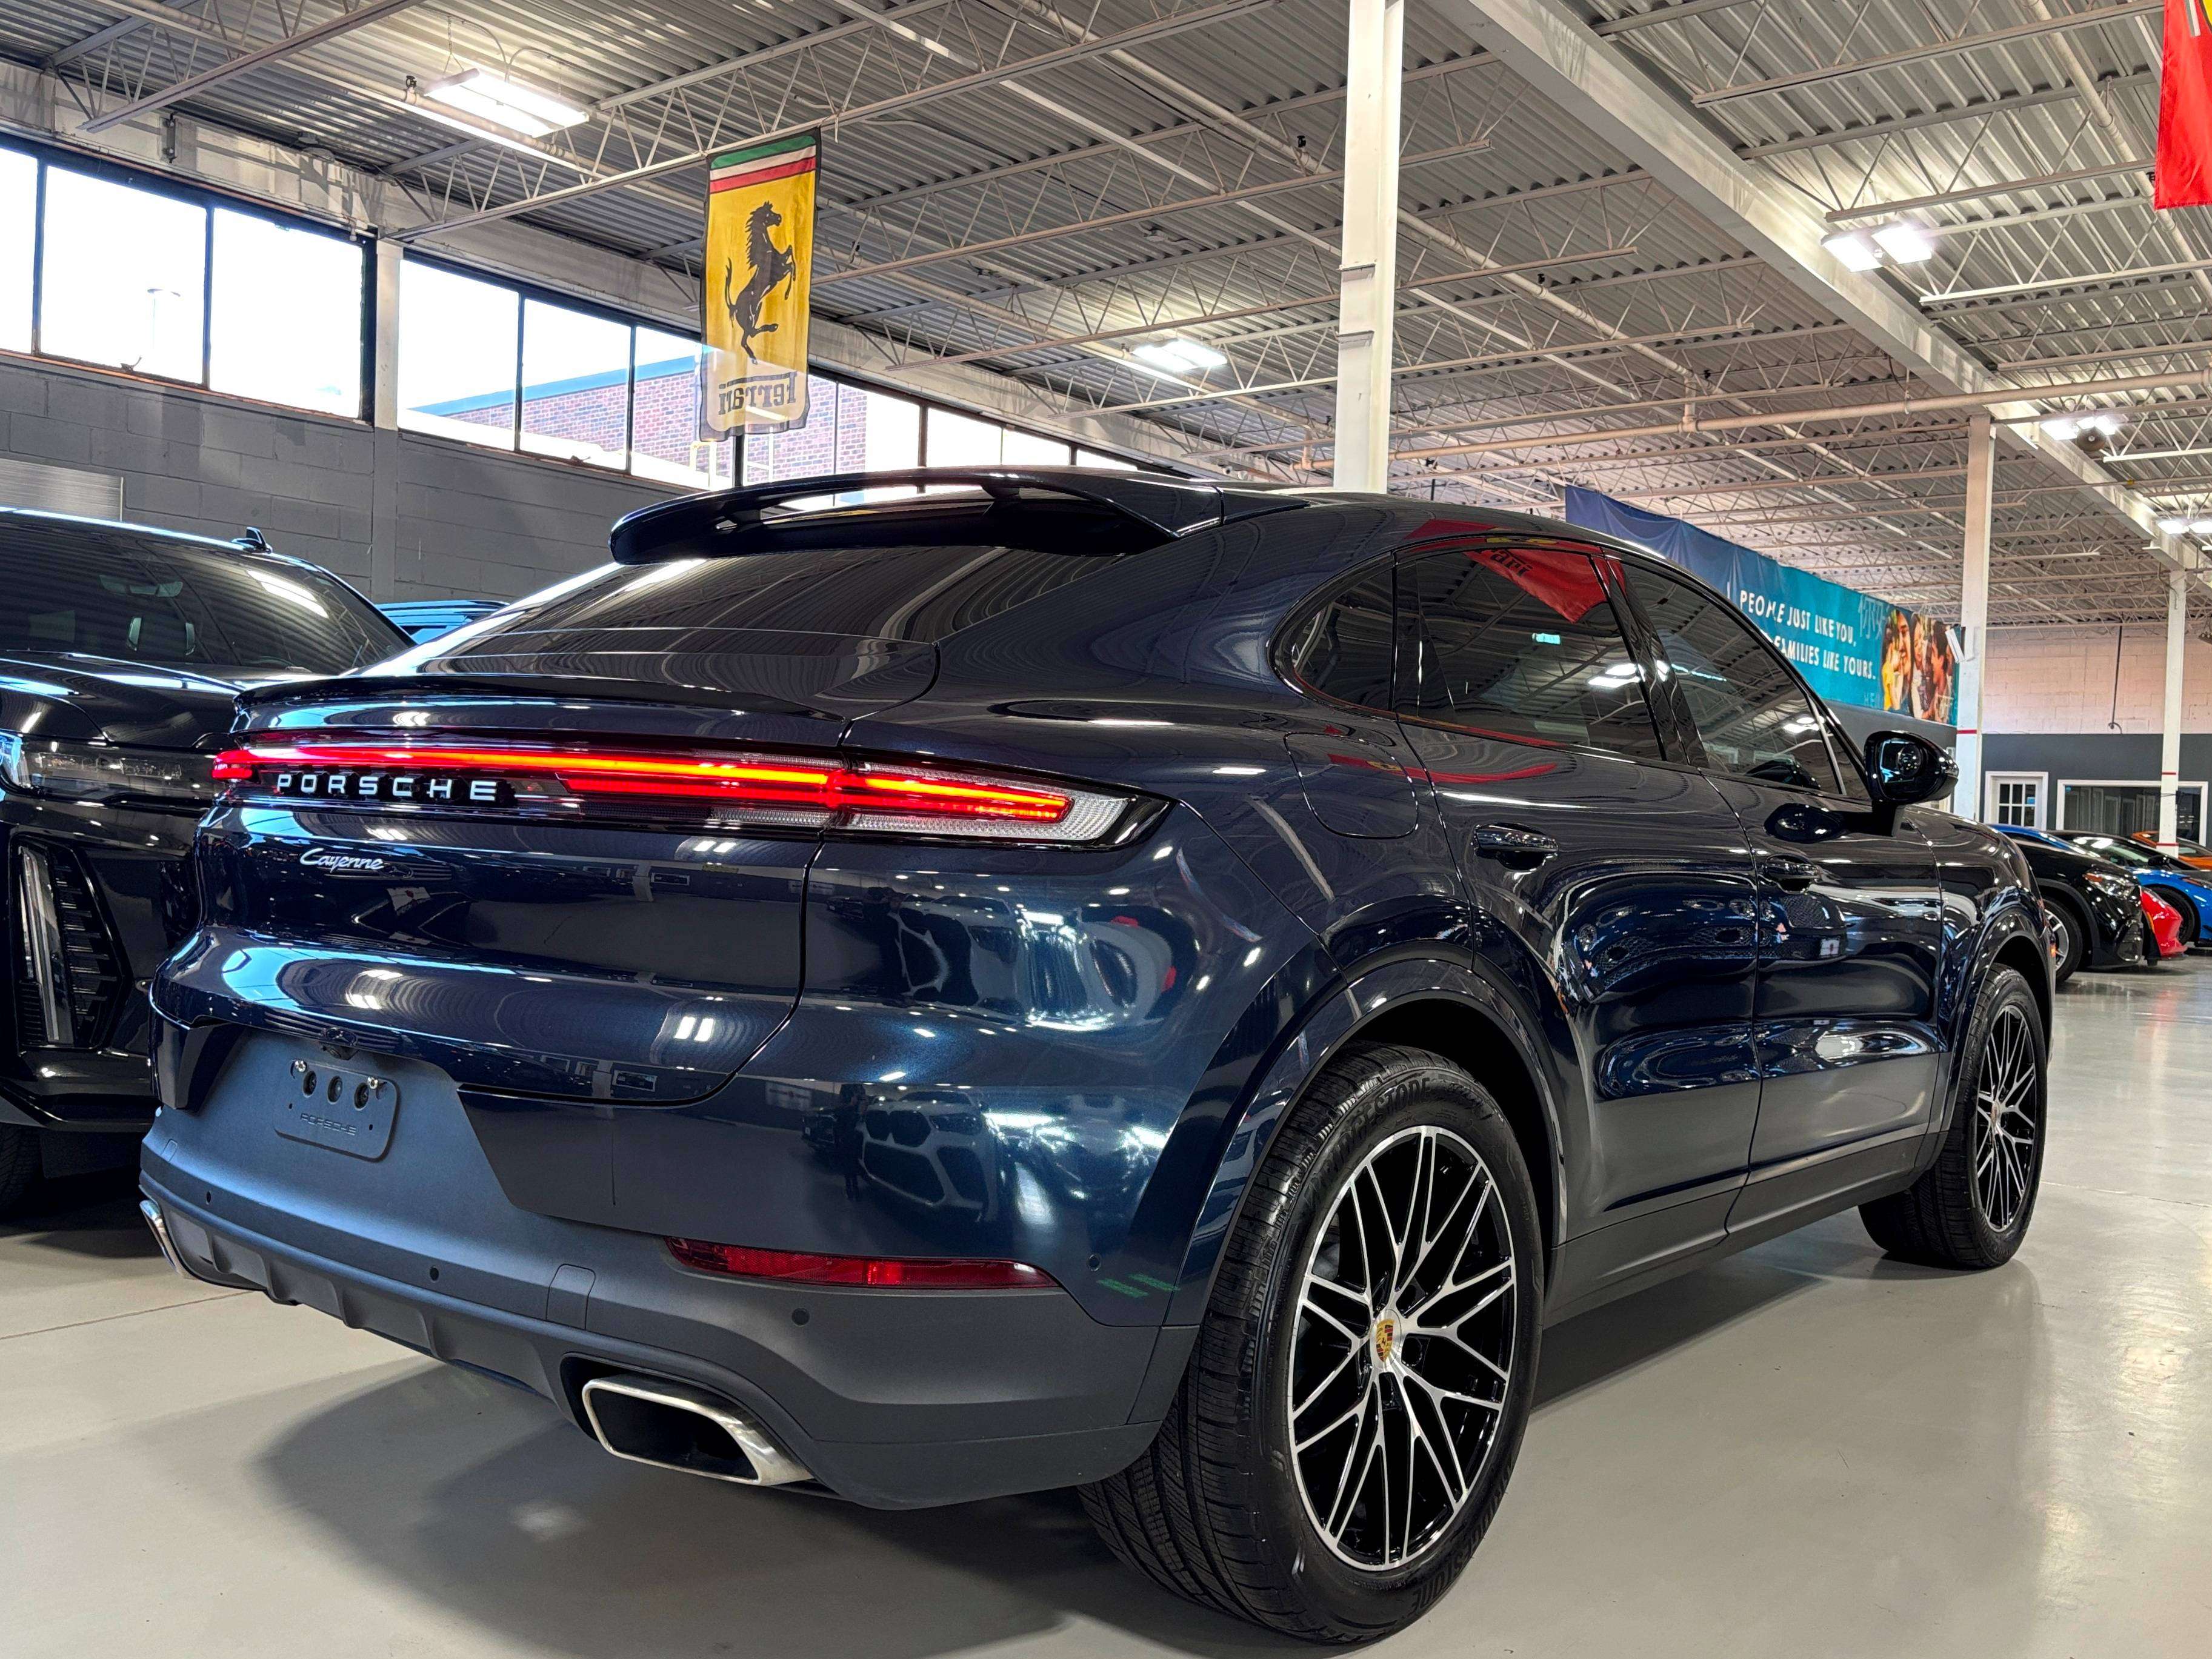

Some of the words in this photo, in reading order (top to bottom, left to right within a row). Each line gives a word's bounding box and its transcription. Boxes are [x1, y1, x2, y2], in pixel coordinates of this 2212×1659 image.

[1787, 607, 1811, 631] JUST
[1814, 614, 1834, 638] LIKE
[1836, 621, 1857, 647] YOU,
[1823, 649, 1840, 671] LIKE
[1843, 655, 1876, 680] YOURS.
[277, 774, 497, 801] PORSCHE
[299, 848, 385, 873] Cayenne
[300, 1112, 358, 1136] PORSCHE
